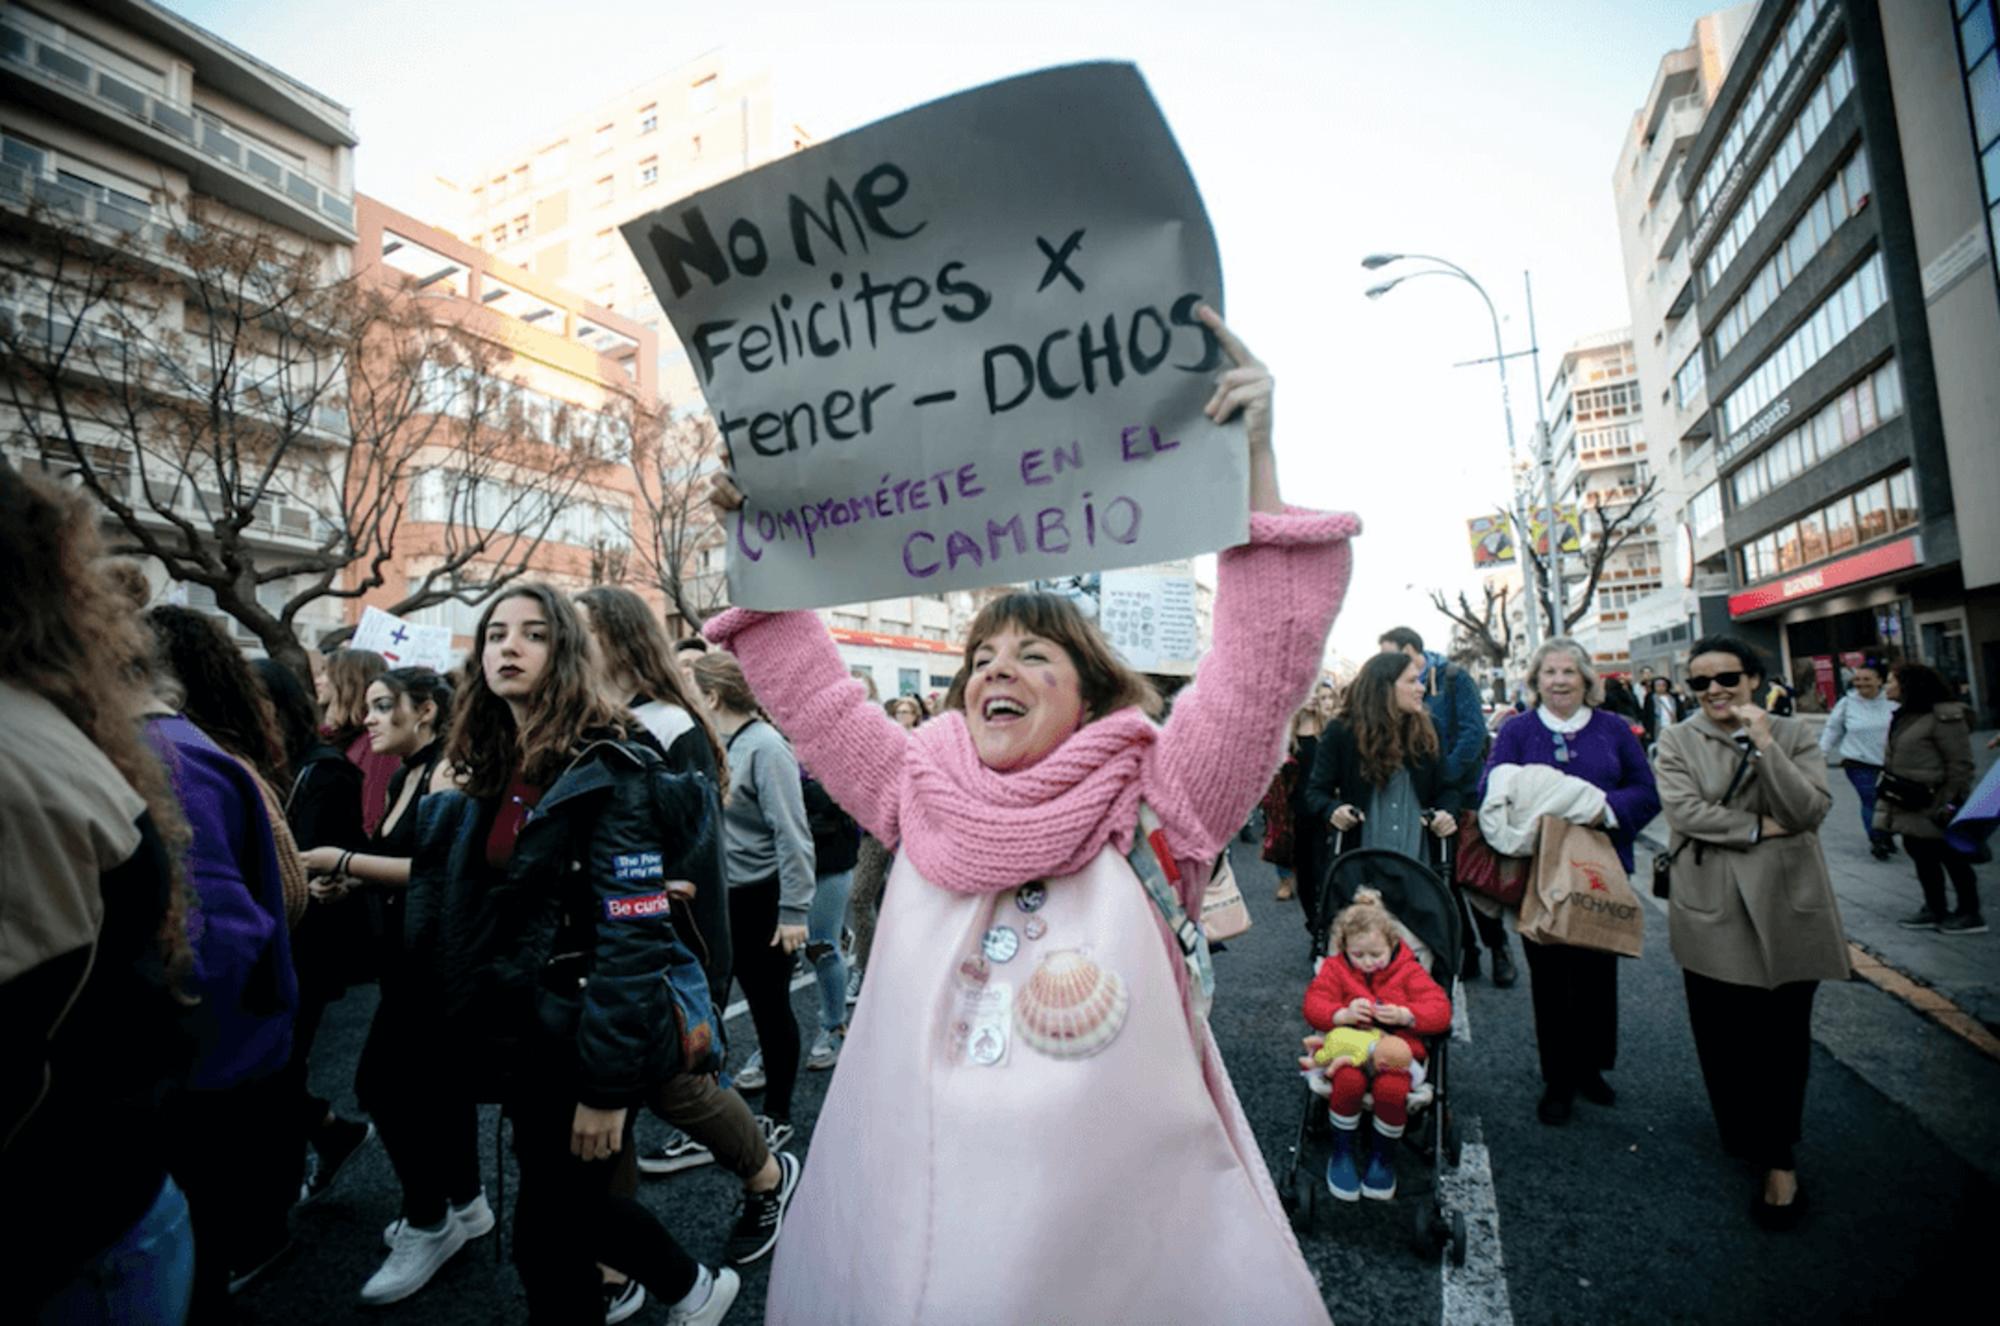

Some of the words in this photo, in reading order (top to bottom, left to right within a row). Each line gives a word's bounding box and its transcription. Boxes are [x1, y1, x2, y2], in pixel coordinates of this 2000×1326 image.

[719, 383, 896, 472] tener
[984, 293, 1222, 415] DCHOS
[1020, 440, 1083, 485] EN
[1121, 426, 1180, 461] EL
[609, 900, 631, 916] Be
